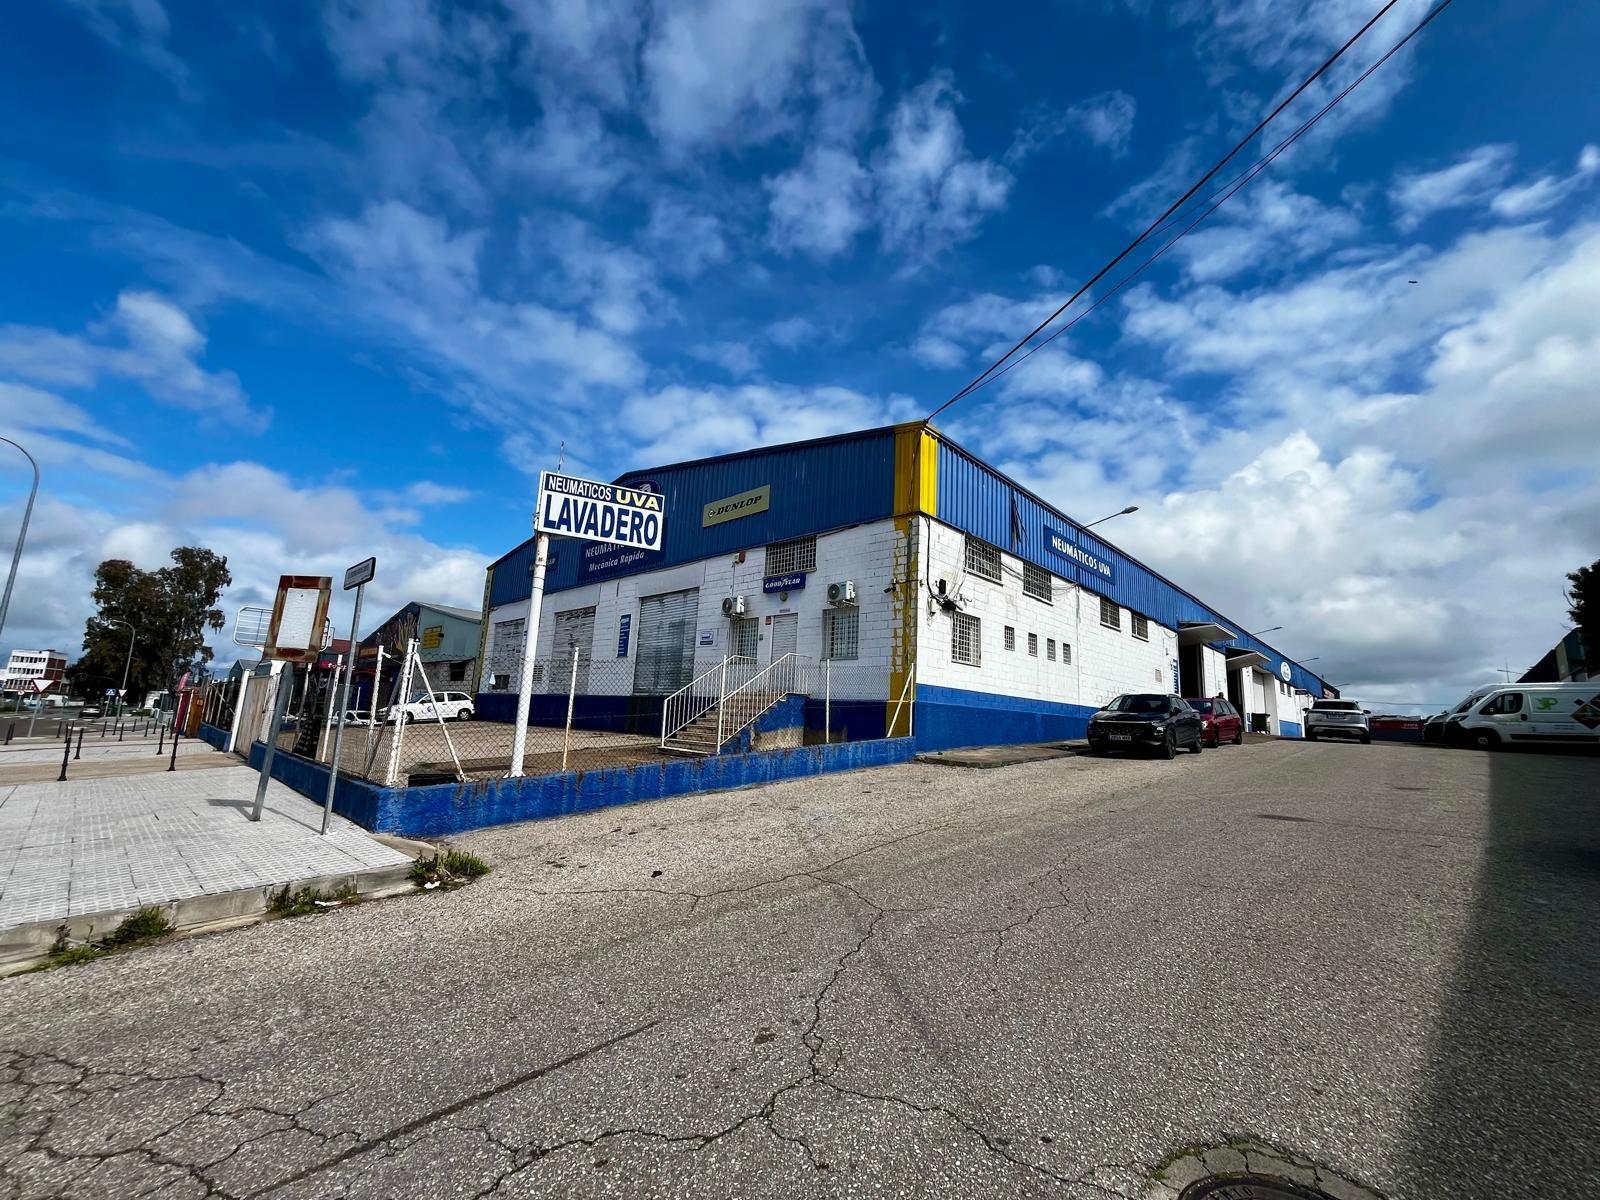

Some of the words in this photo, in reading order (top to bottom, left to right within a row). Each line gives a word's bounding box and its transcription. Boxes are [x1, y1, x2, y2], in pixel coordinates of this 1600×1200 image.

[548, 475, 612, 501] NEUMÁTICOS
[616, 489, 660, 511] UVA
[716, 495, 762, 516] DUNLOP
[543, 494, 658, 547] LAVADERO
[1052, 535, 1097, 570] NEUMÁTICOS
[1098, 561, 1112, 577] UVA
[765, 578, 801, 589] GOODYEAR
